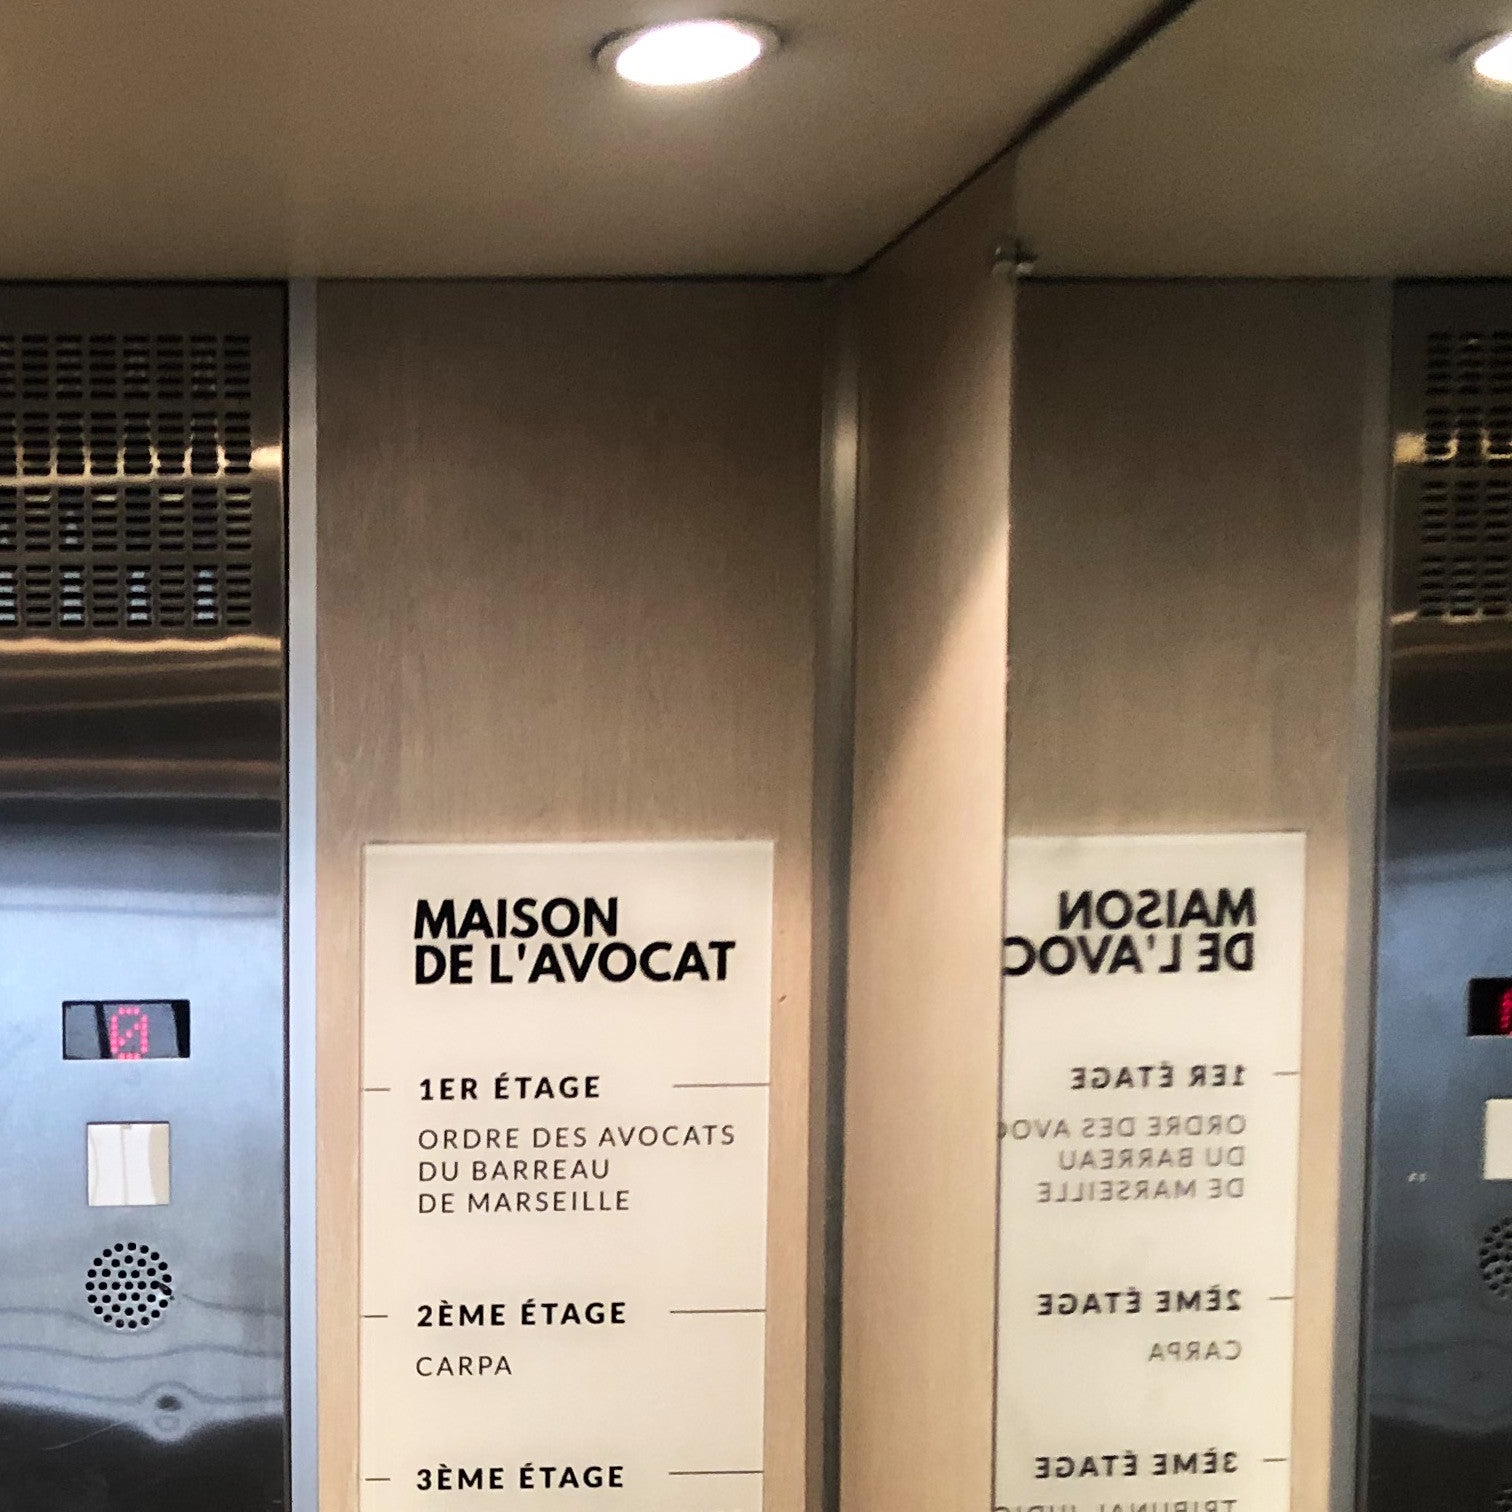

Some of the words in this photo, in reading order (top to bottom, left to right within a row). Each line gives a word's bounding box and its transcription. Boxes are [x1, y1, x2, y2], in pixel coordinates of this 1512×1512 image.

[414, 897, 618, 939] MAISON
[415, 944, 473, 985] DE
[490, 941, 736, 984] L'AVOCAT
[109, 1005, 149, 1060] 0
[420, 1077, 477, 1100] 1ER
[495, 1072, 600, 1099] ÉTAGE
[418, 1128, 519, 1150] ORDRE
[533, 1127, 587, 1148] DES
[599, 1125, 735, 1147] AVOCATS
[419, 1161, 458, 1181] DU
[473, 1159, 609, 1181] BARREAU
[419, 1193, 454, 1213] DE
[468, 1190, 629, 1213] MARSEILLE
[417, 1300, 505, 1327] 2ÈME
[521, 1299, 626, 1326] ÉTAGE
[416, 1356, 512, 1377] CARPA
[417, 1464, 504, 1491] 3ÈME
[519, 1462, 624, 1489] ÉTAGE
